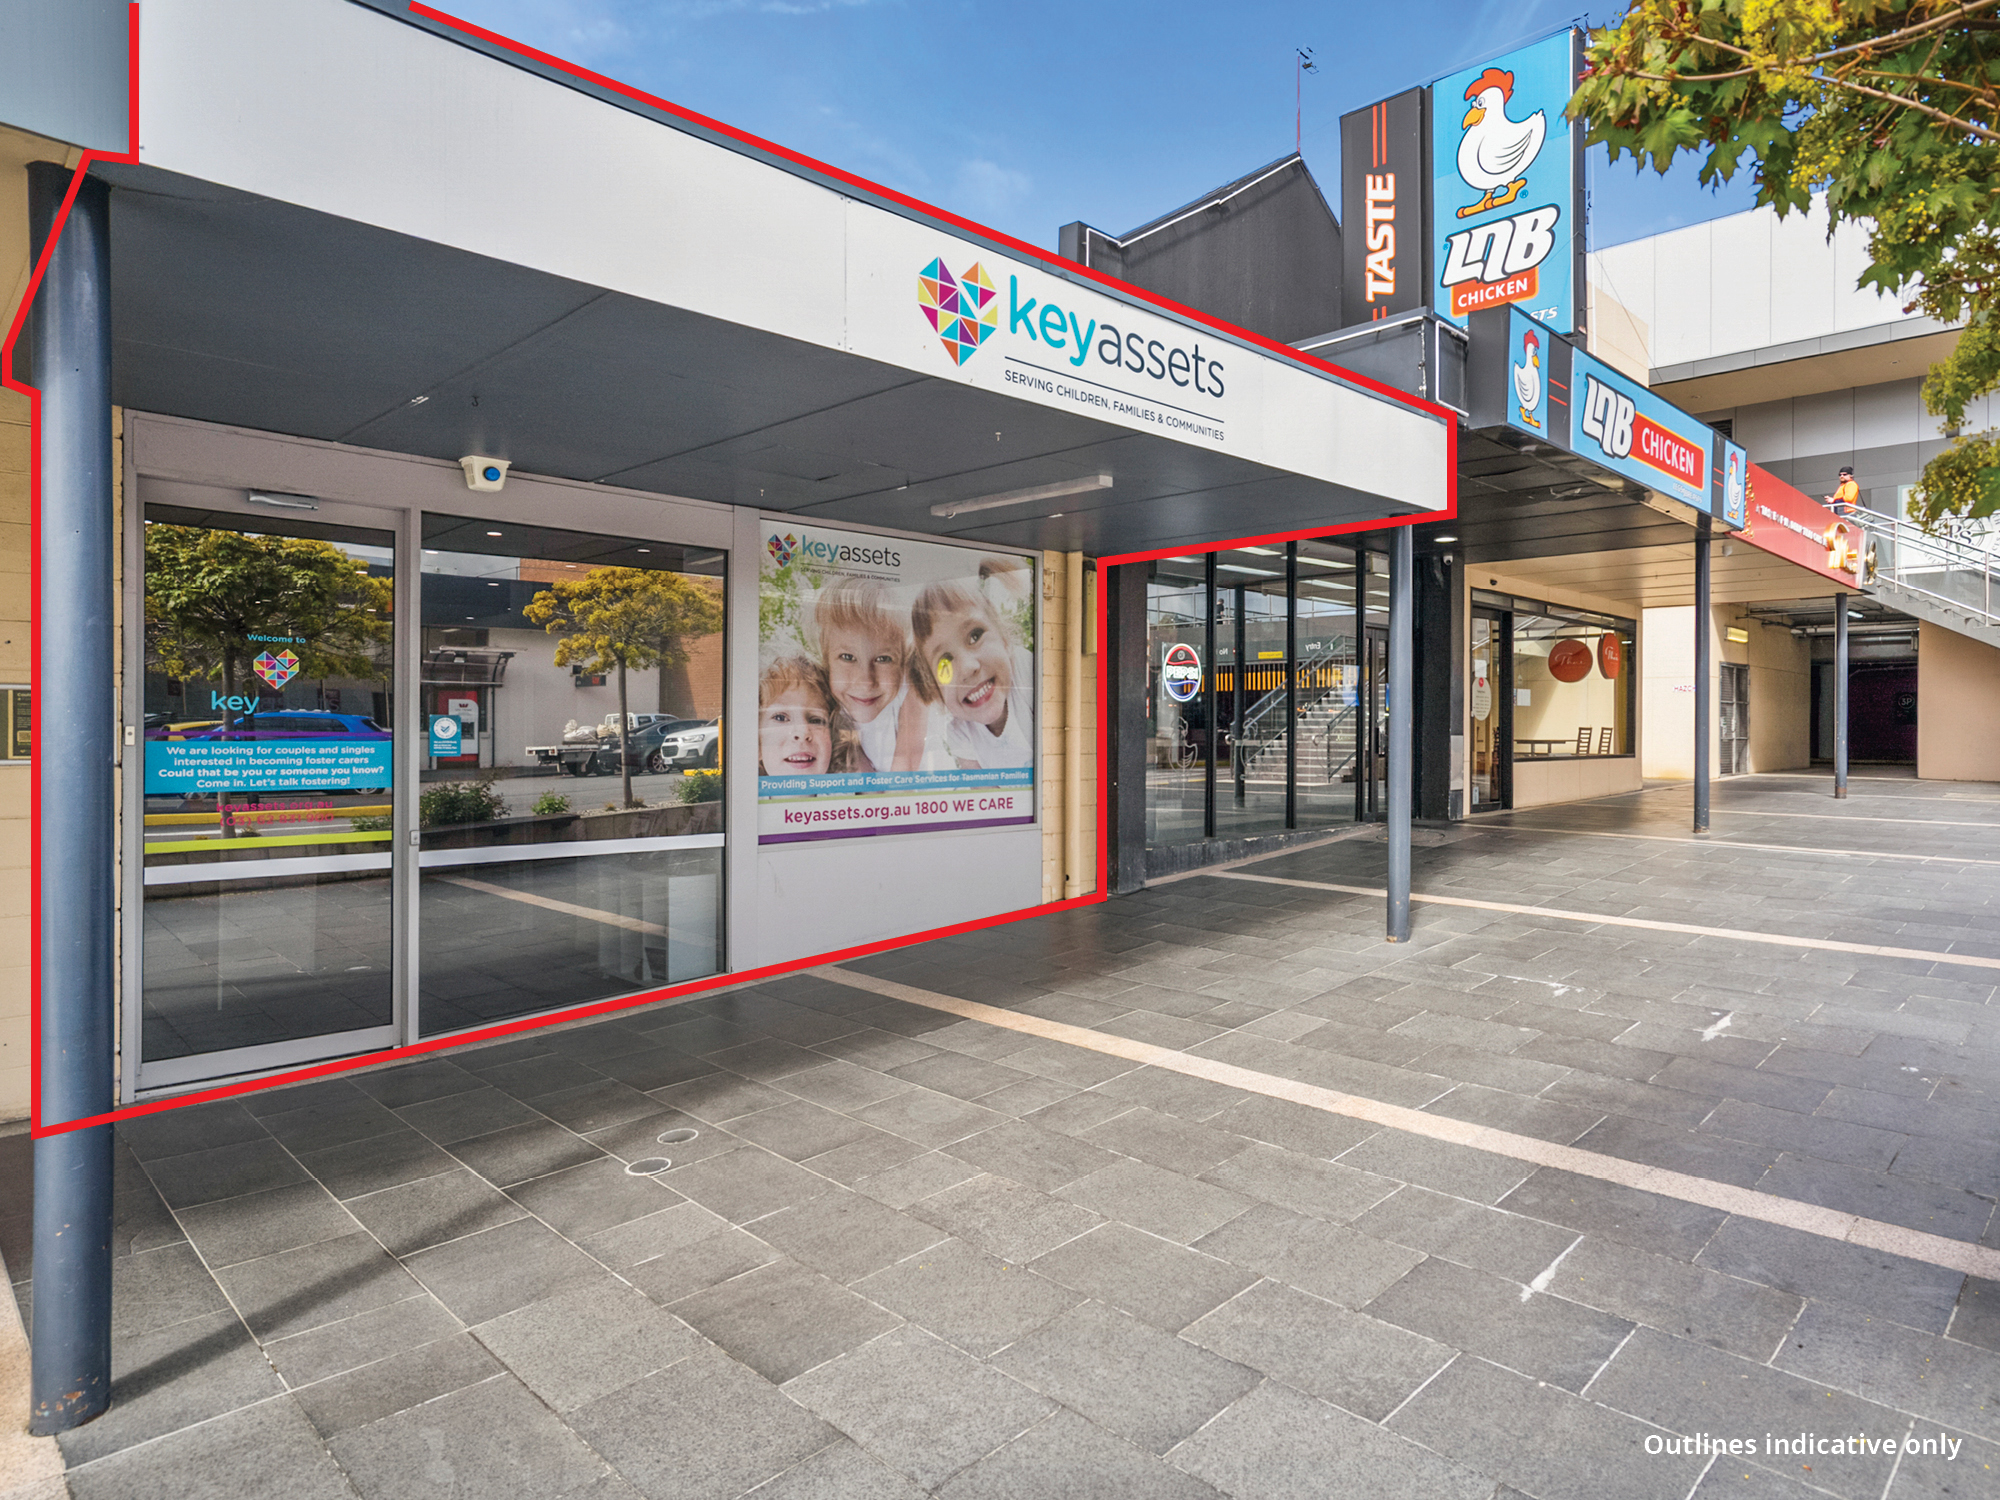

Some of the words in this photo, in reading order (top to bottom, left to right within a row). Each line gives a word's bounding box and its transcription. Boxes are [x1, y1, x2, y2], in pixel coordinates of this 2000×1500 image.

[1365, 173, 1396, 302] TASTE
[1458, 278, 1528, 308] CHICKEN
[1009, 274, 1225, 398] keyassets
[1004, 369, 1054, 393] SERVING
[1056, 384, 1111, 410] CHILDREN,
[1113, 400, 1156, 421] FAMILIES
[1157, 413, 1164, 424] &
[1165, 415, 1225, 441] COMMUNITIES
[1641, 427, 1694, 476] CHICKEN
[802, 534, 901, 567] keyassets
[800, 567, 821, 575] SERVING
[846, 572, 866, 580] FAMILIES
[871, 575, 901, 583] COMMUNITIES
[247, 633, 293, 643] Welcome
[295, 636, 306, 644] to
[1166, 665, 1199, 679] PEPSI
[166, 747, 186, 755] We
[211, 746, 253, 756] looking
[256, 746, 272, 754] for
[275, 746, 316, 755] couples
[318, 746, 339, 754] and
[341, 746, 375, 755] singles
[174, 757, 233, 766] interested
[236, 757, 246, 765] in
[249, 757, 303, 766] becoming
[305, 756, 336, 765] foster
[338, 756, 369, 764] carers
[158, 769, 194, 777] Could
[197, 768, 221, 777] that
[224, 768, 239, 776] be
[242, 769, 262, 778] you
[280, 768, 329, 776] someone
[331, 768, 350, 776] you
[352, 766, 384, 774] know?
[196, 779, 230, 788] Come
[233, 779, 246, 787] in.
[250, 778, 276, 786] Let's
[279, 778, 298, 786] talk
[301, 777, 351, 786] fostering!
[761, 780, 807, 790] Providing
[809, 778, 845, 788] Support
[847, 777, 864, 786] and
[866, 776, 892, 785] Foster
[894, 775, 913, 784] Care
[915, 774, 947, 783] Services
[949, 773, 960, 782] for
[961, 772, 999, 781] Tasmanian
[1000, 771, 1029, 780] Families
[216, 801, 333, 812] keyassets.org.au
[784, 805, 911, 825] keyassets.org.au
[915, 800, 948, 815] 1800
[952, 799, 975, 812] WE
[978, 796, 1014, 811] CARE
[220, 816, 252, 827] (03)
